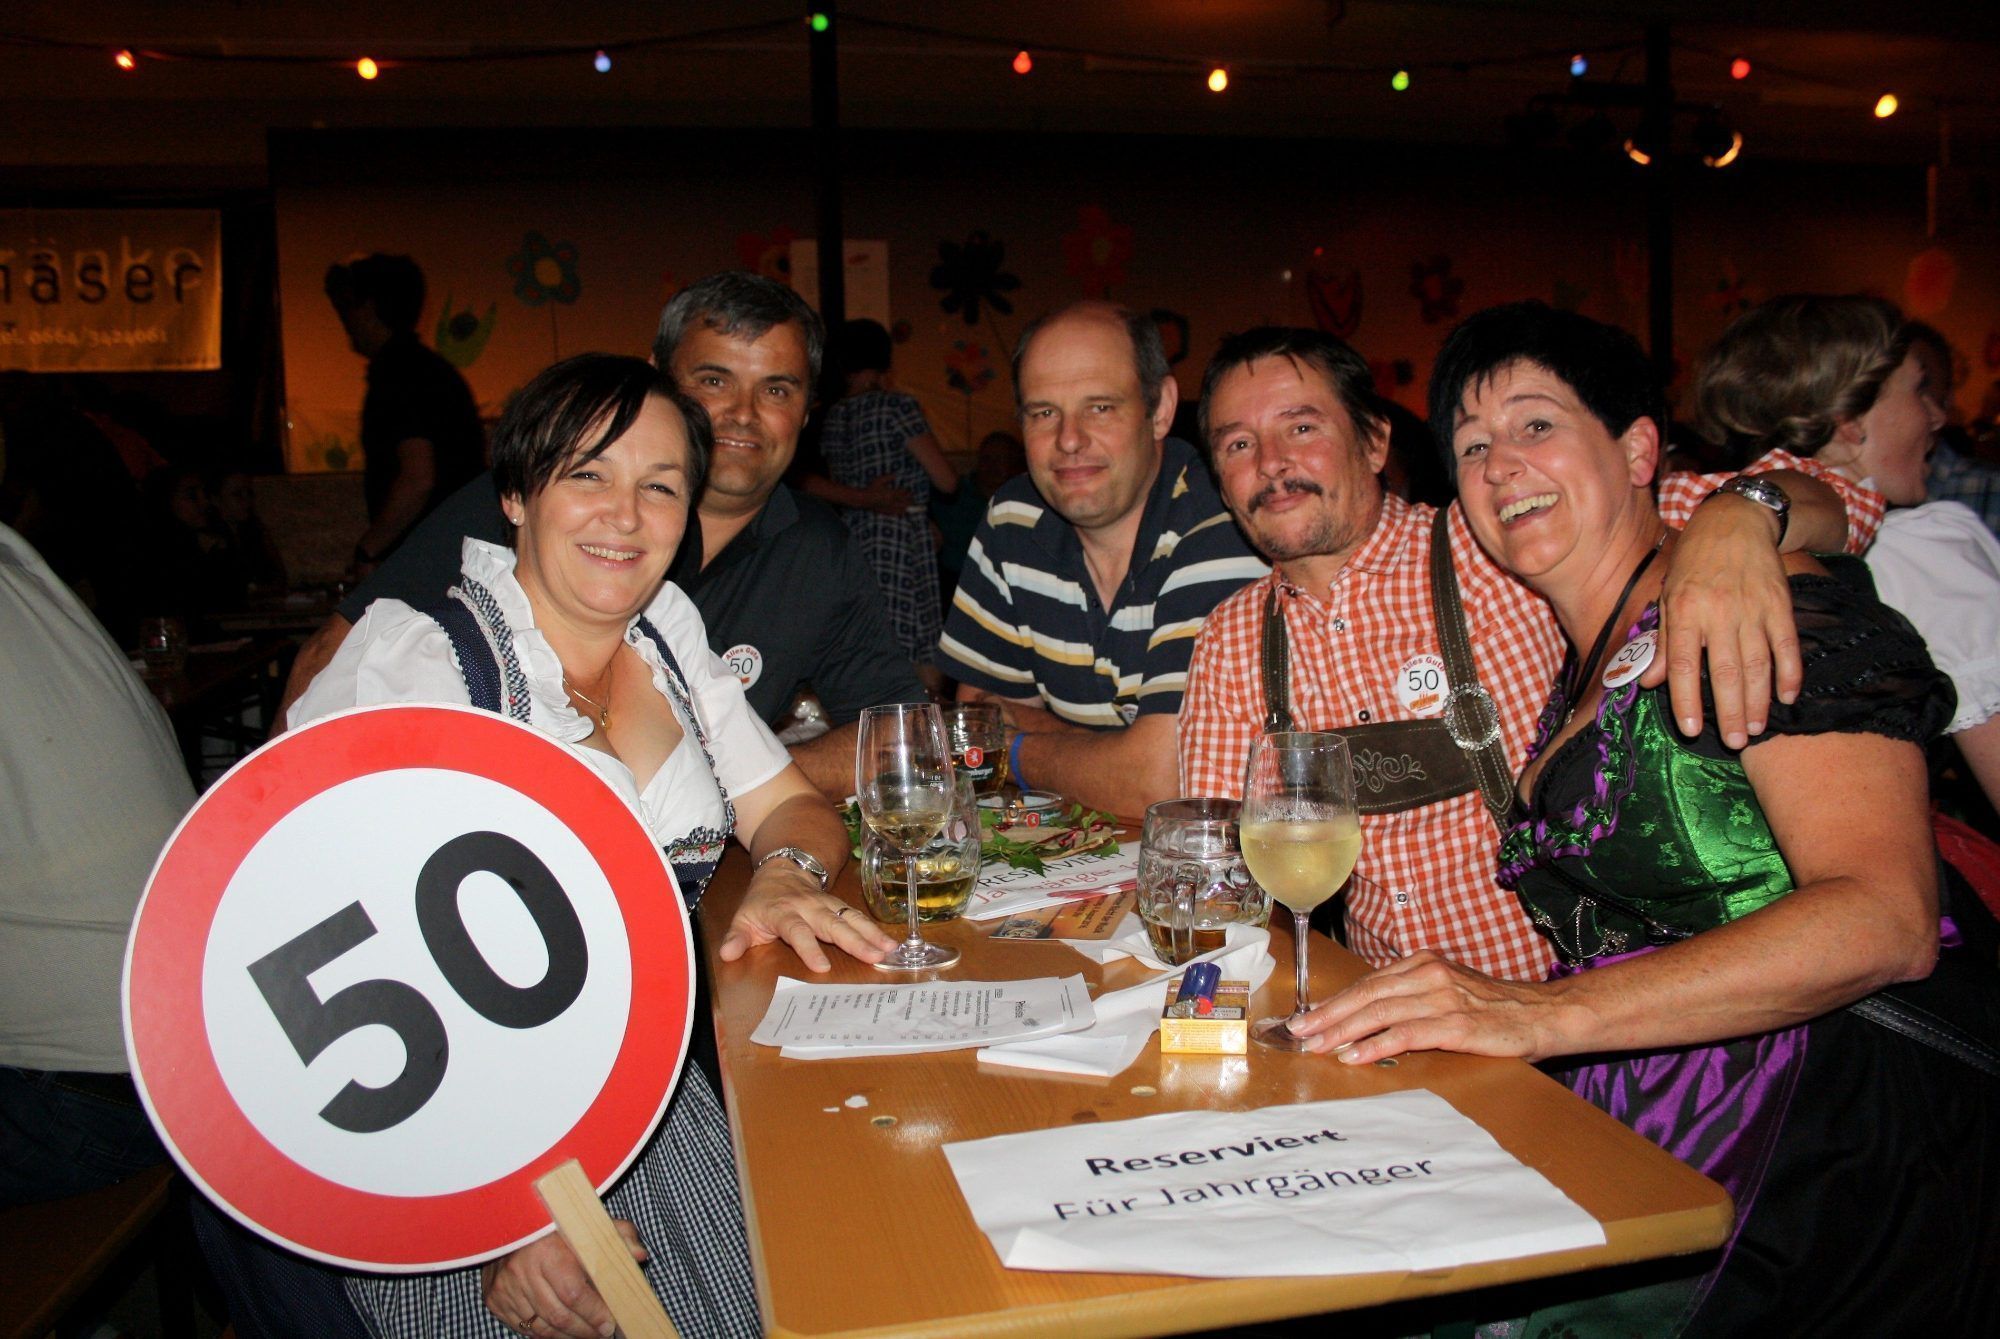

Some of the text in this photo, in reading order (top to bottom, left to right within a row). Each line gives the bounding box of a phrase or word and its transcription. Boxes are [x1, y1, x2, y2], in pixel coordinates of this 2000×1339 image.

[725, 647, 759, 660] Alles Gute
[1618, 642, 1650, 662] 50
[729, 657, 753, 675] 50
[1402, 657, 1424, 673] Alles
[1408, 669, 1439, 691] 50
[246, 830, 589, 1134] 50
[1085, 1129, 1348, 1176] Reserviert
[1052, 1159, 1434, 1221] Für Jahrgänger
